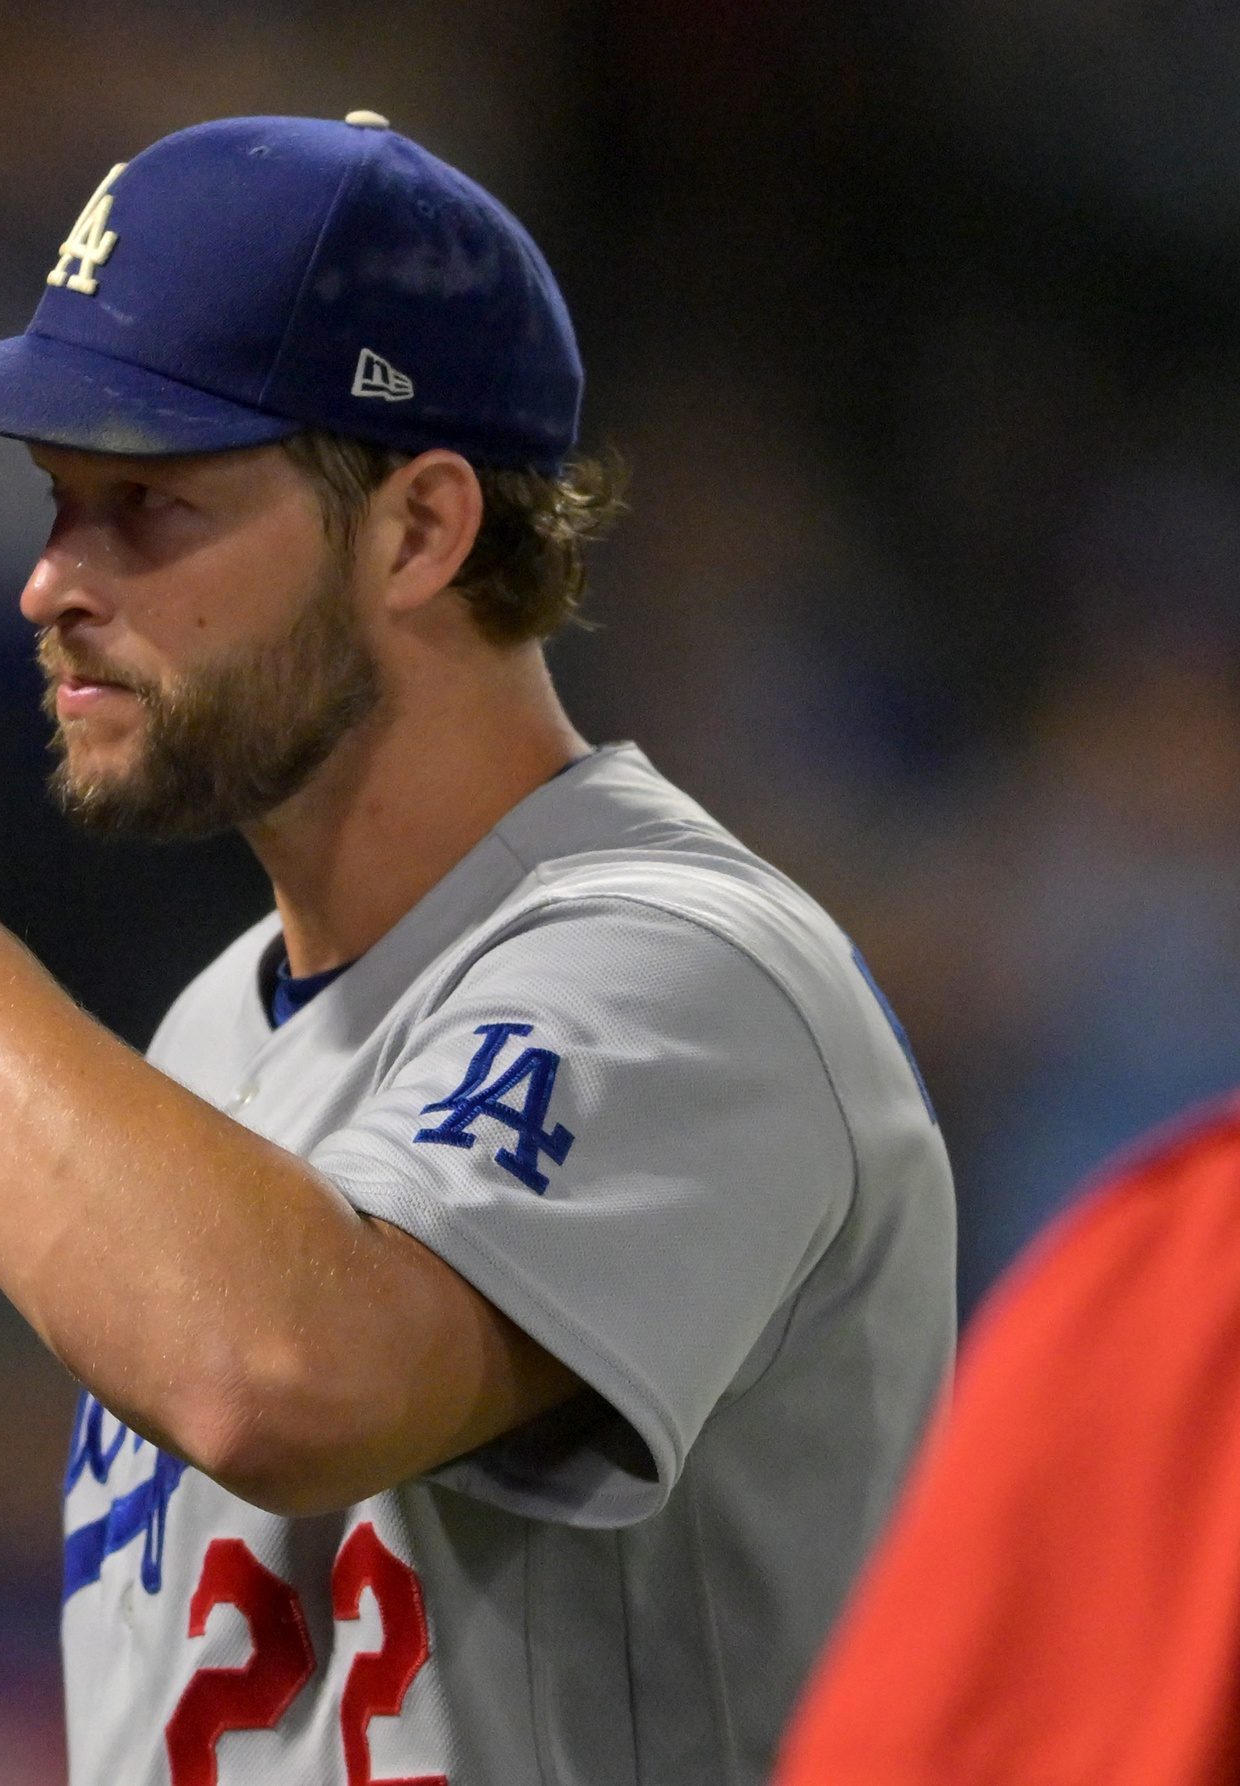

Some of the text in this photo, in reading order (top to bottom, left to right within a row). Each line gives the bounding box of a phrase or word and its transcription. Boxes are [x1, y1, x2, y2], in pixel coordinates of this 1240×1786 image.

[46, 162, 128, 294] LA
[412, 1022, 576, 1196] LA
[165, 1521, 450, 1786] 22
